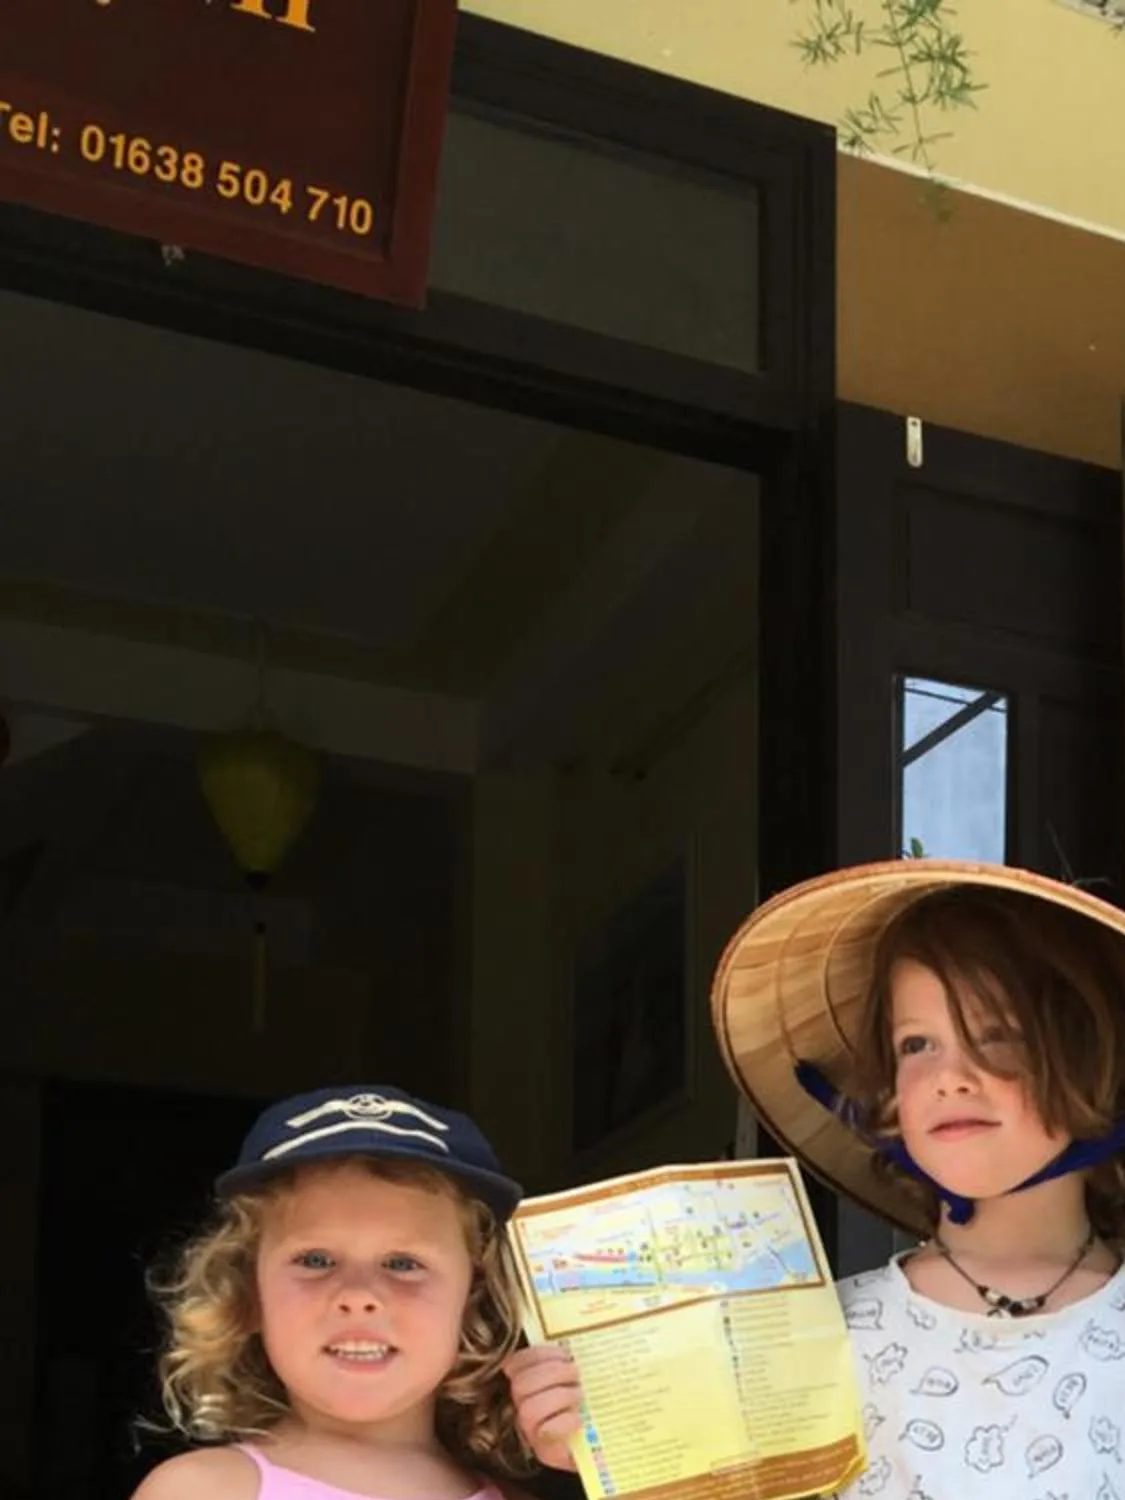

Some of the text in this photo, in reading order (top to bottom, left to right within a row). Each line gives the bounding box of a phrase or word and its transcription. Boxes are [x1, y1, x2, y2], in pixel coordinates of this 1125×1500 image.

[80, 124, 204, 188] 01638
[216, 161, 292, 214] 504
[305, 187, 373, 235] 710
